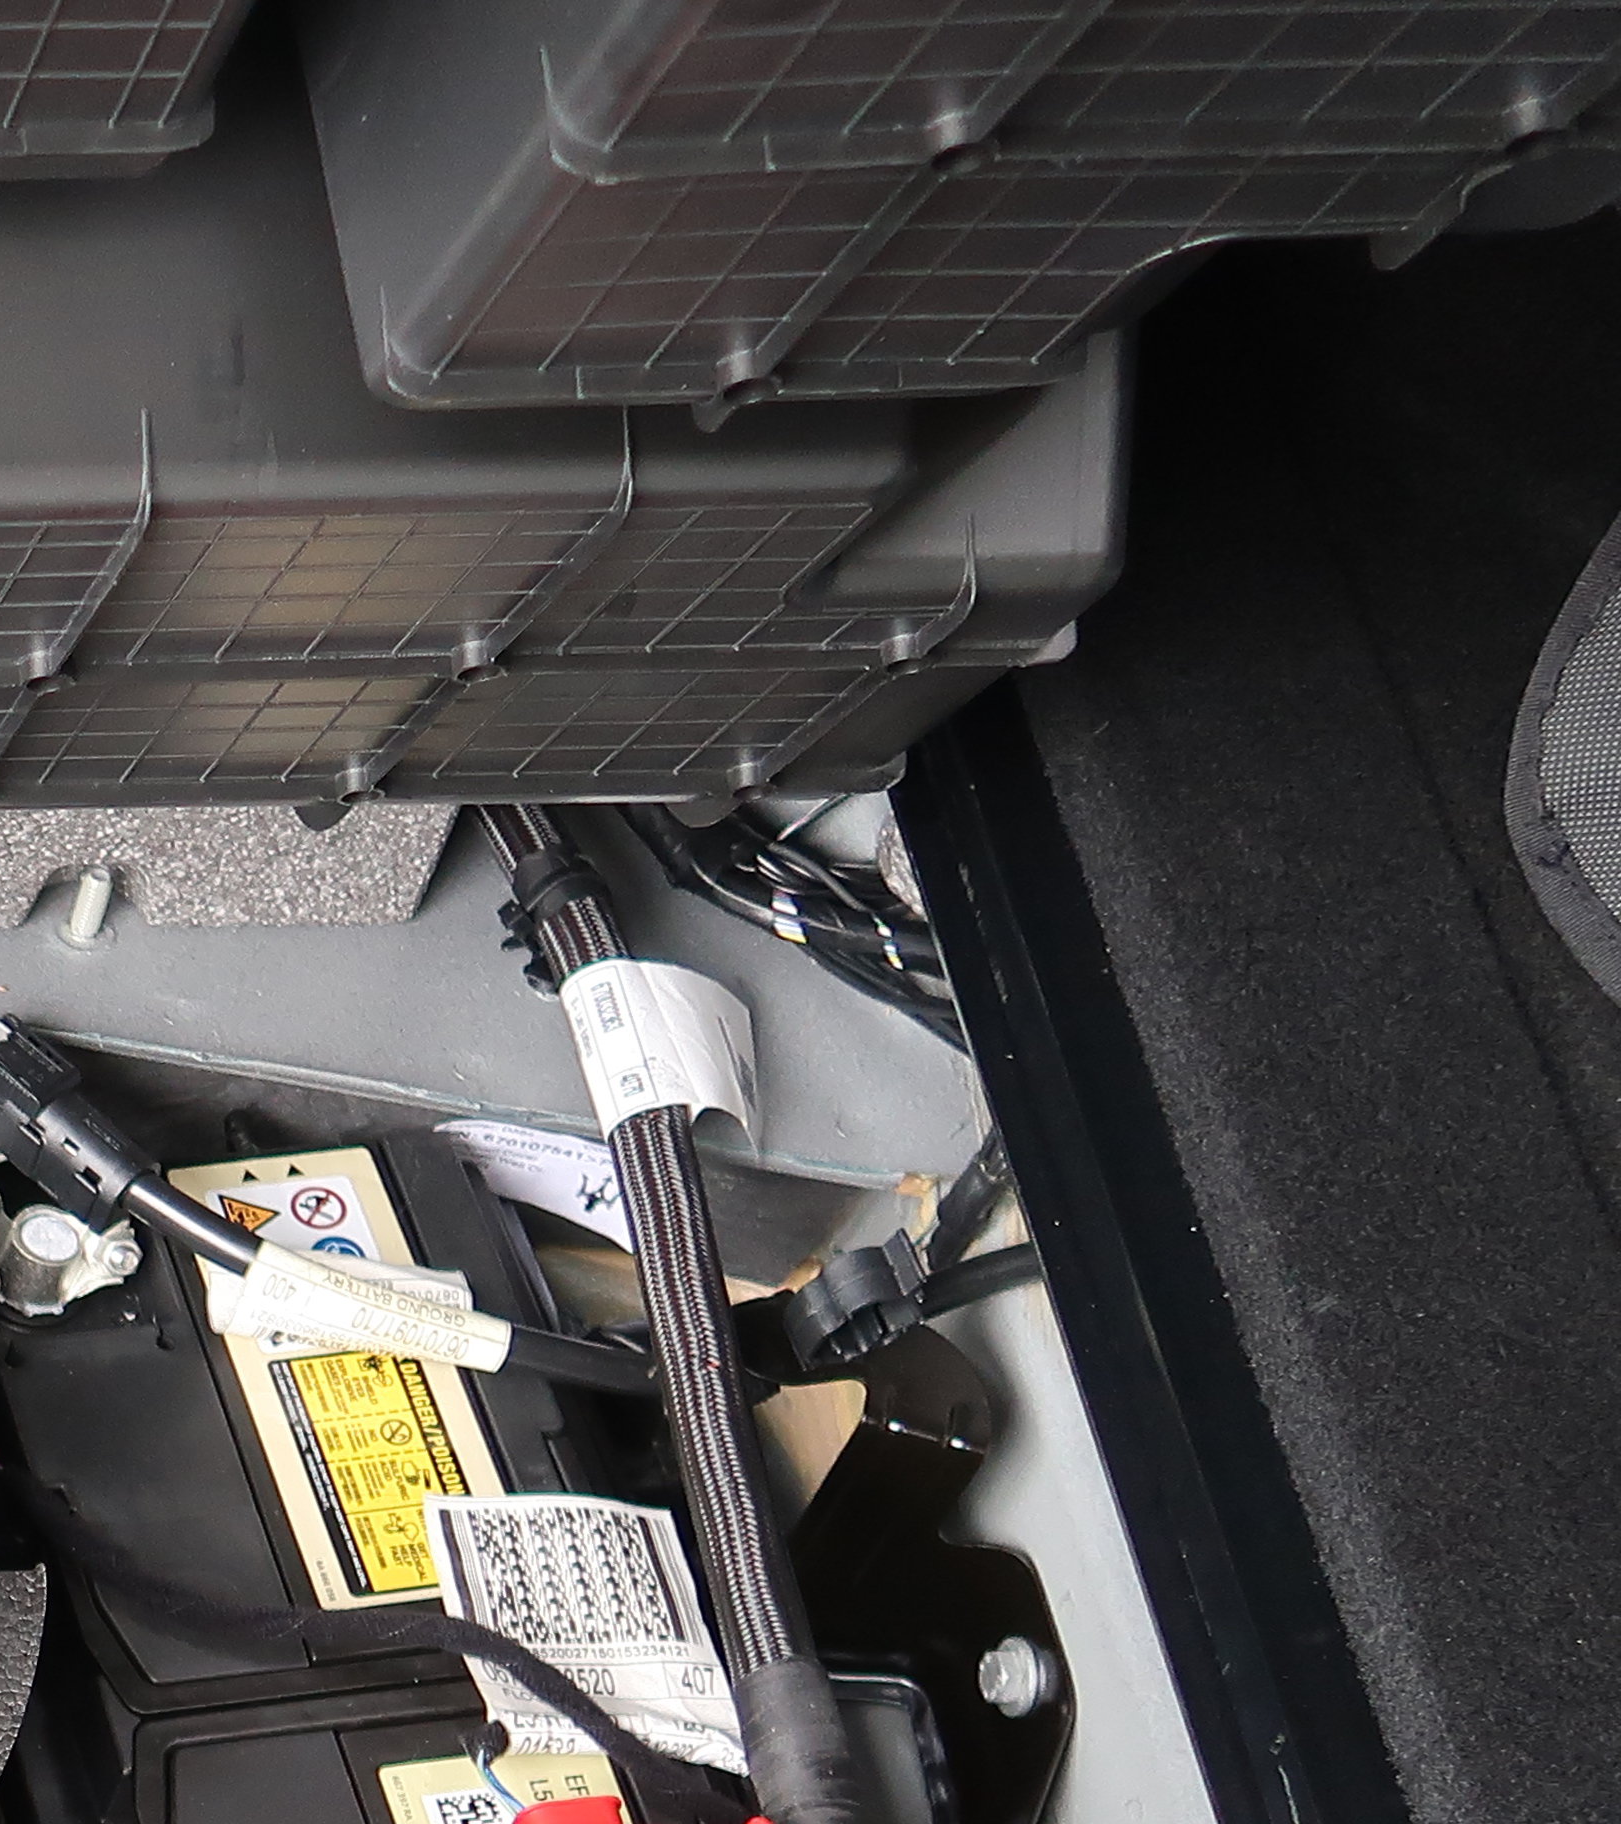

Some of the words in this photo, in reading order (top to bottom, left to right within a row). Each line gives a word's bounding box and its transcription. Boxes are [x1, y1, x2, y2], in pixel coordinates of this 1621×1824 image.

[260, 1272, 297, 1300] 400
[317, 1270, 392, 1305] BATTERY
[396, 1296, 465, 1326] GROUND
[399, 1363, 465, 1495] DANGER/POISON
[378, 1459, 392, 1481] ACID
[388, 1459, 410, 1501] SULFURIC
[388, 1545, 403, 1566] FAST
[399, 1544, 413, 1567] HELP
[408, 1542, 428, 1581] MEDICAL
[415, 1541, 429, 1559] GET
[681, 1667, 714, 1695] 407
[527, 1778, 553, 1801] L5
